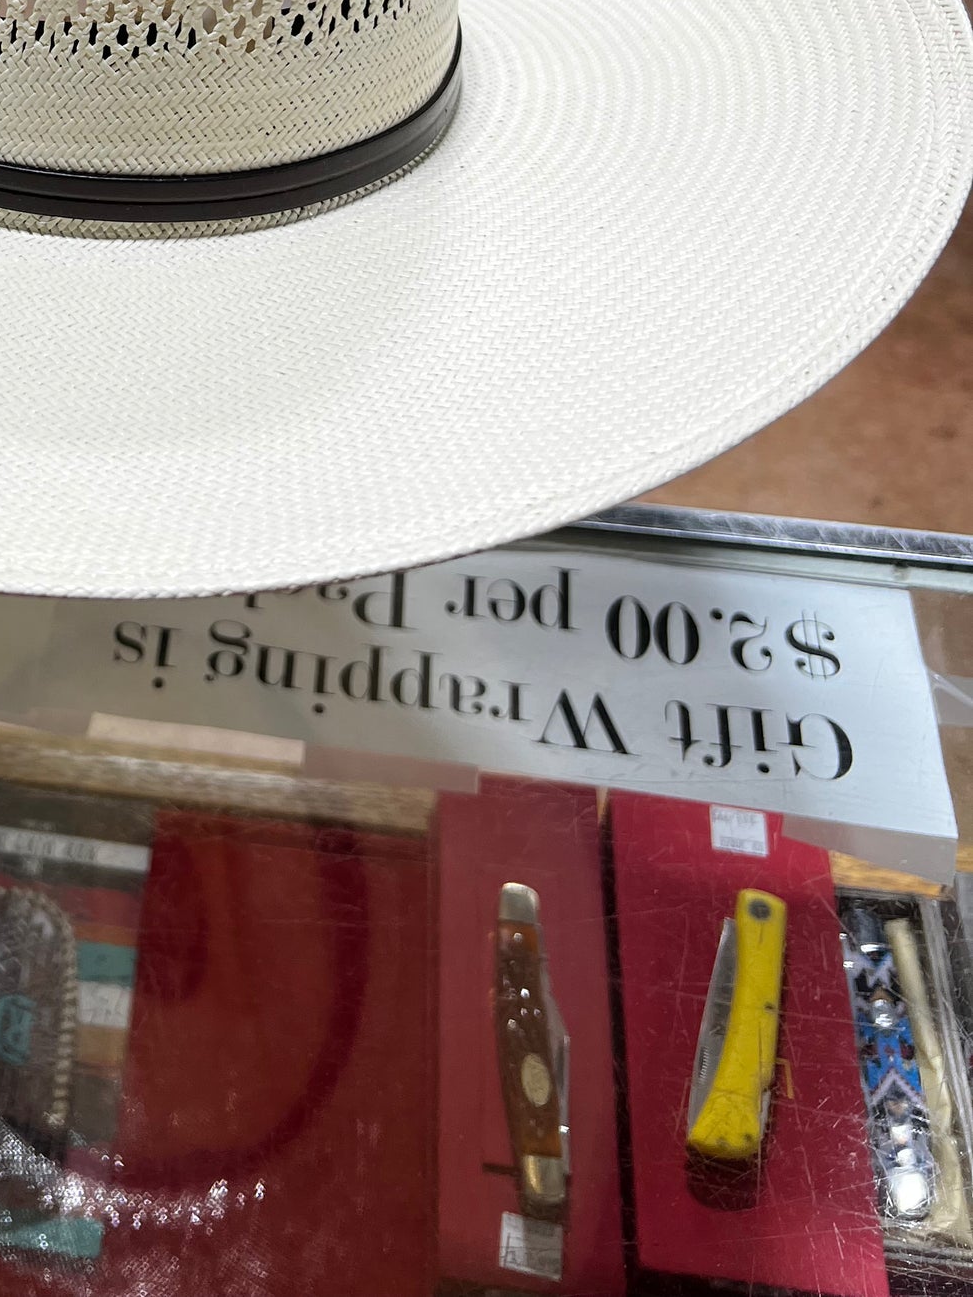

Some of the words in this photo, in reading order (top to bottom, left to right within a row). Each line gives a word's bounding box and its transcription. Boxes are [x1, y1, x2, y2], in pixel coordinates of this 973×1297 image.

[445, 567, 581, 631] per
[605, 594, 841, 680] $2.00
[113, 621, 182, 689] is
[205, 619, 641, 756] Wrapping
[664, 700, 853, 780] Gift
